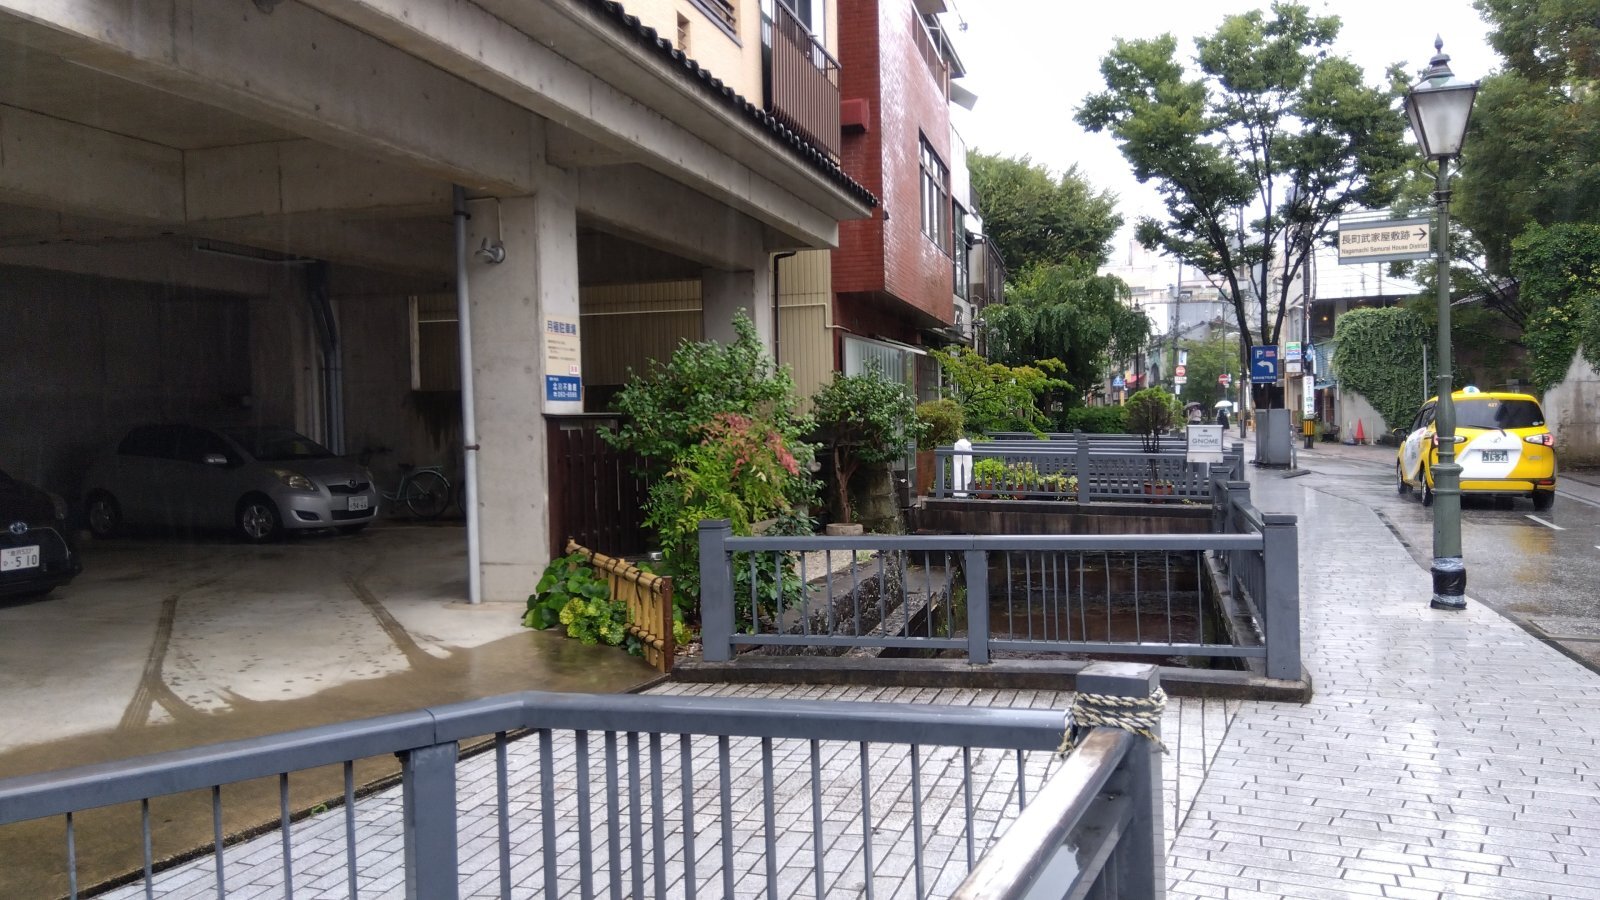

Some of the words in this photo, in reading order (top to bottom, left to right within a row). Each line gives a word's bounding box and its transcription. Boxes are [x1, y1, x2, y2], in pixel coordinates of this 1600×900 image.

[1342, 231, 1410, 245] 長町武家屋敷跡
[1341, 246, 1369, 255] Nagamachi
[1409, 242, 1428, 250] District
[1256, 350, 1264, 359] P
